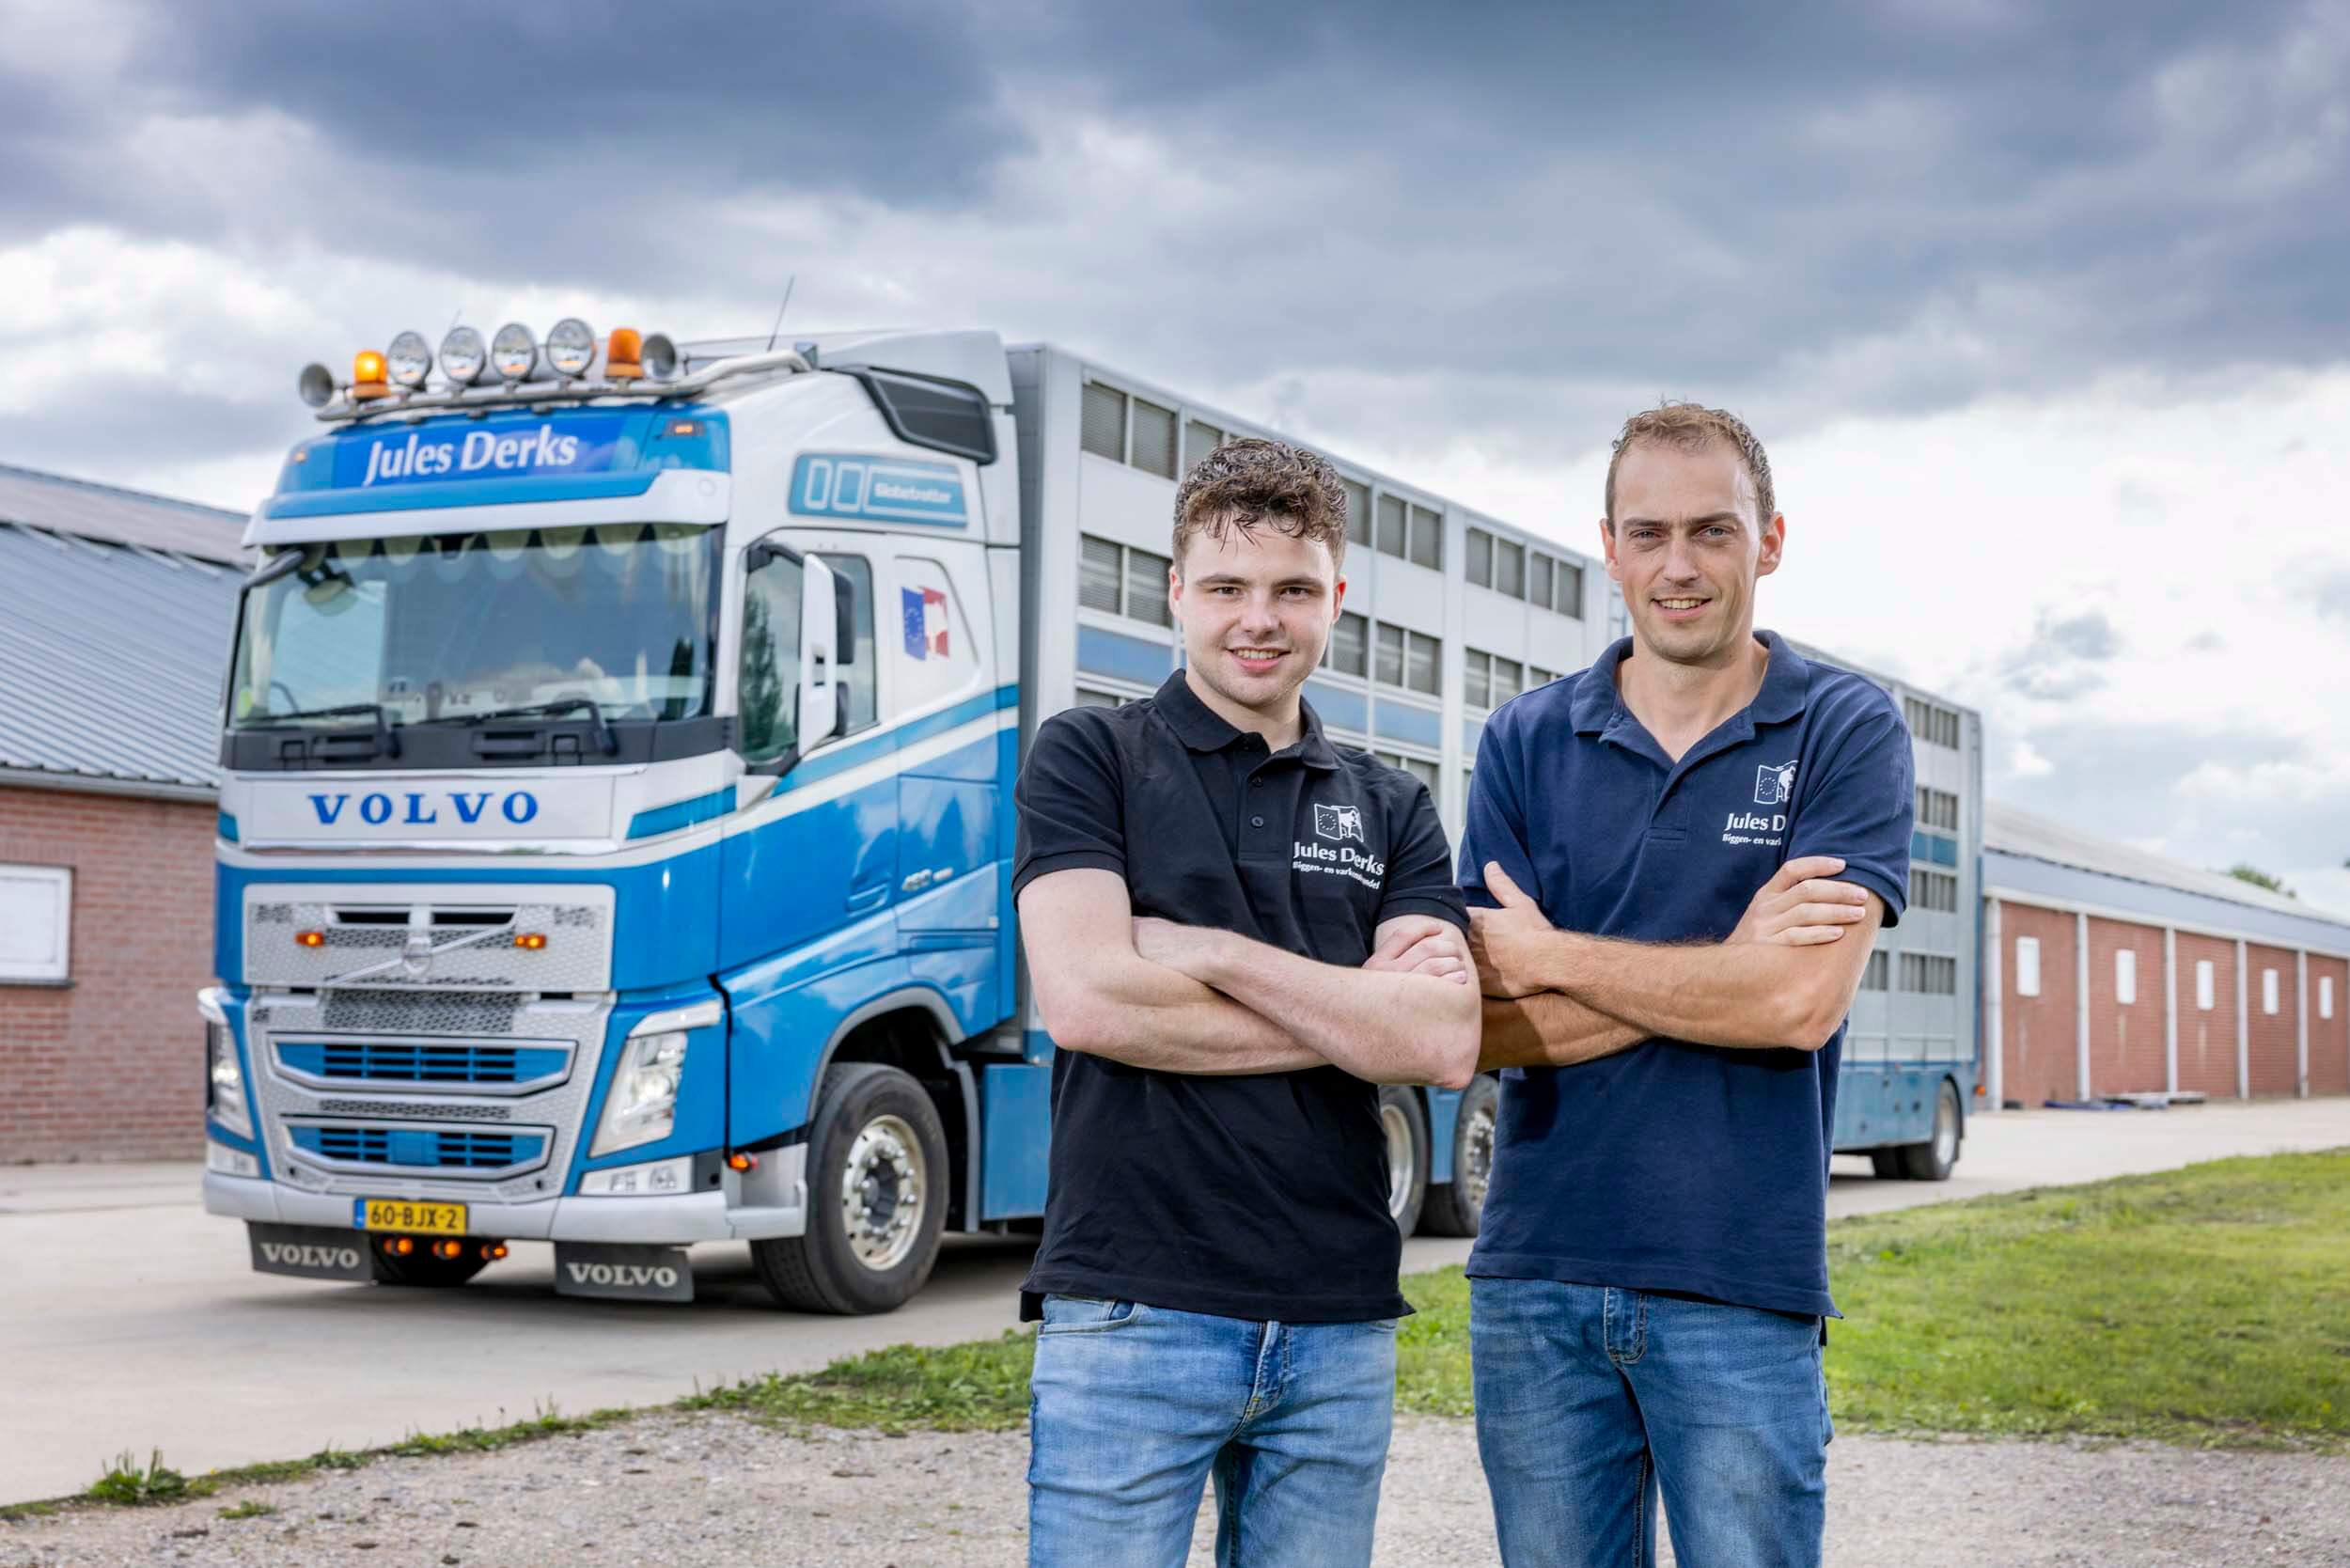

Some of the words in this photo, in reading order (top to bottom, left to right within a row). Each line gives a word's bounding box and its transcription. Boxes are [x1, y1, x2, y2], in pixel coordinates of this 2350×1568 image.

[363, 434, 453, 487] Jules
[460, 425, 578, 471] Derks
[307, 791, 539, 824] VOLVO
[1724, 812, 1769, 832] Jules
[1753, 838, 1764, 846] en
[1292, 841, 1338, 862] Jules
[1340, 847, 1386, 876] Derks
[370, 1202, 460, 1230] 60-BJX-2
[260, 1242, 360, 1269] VOLVO
[566, 1261, 678, 1288] VOLVO
